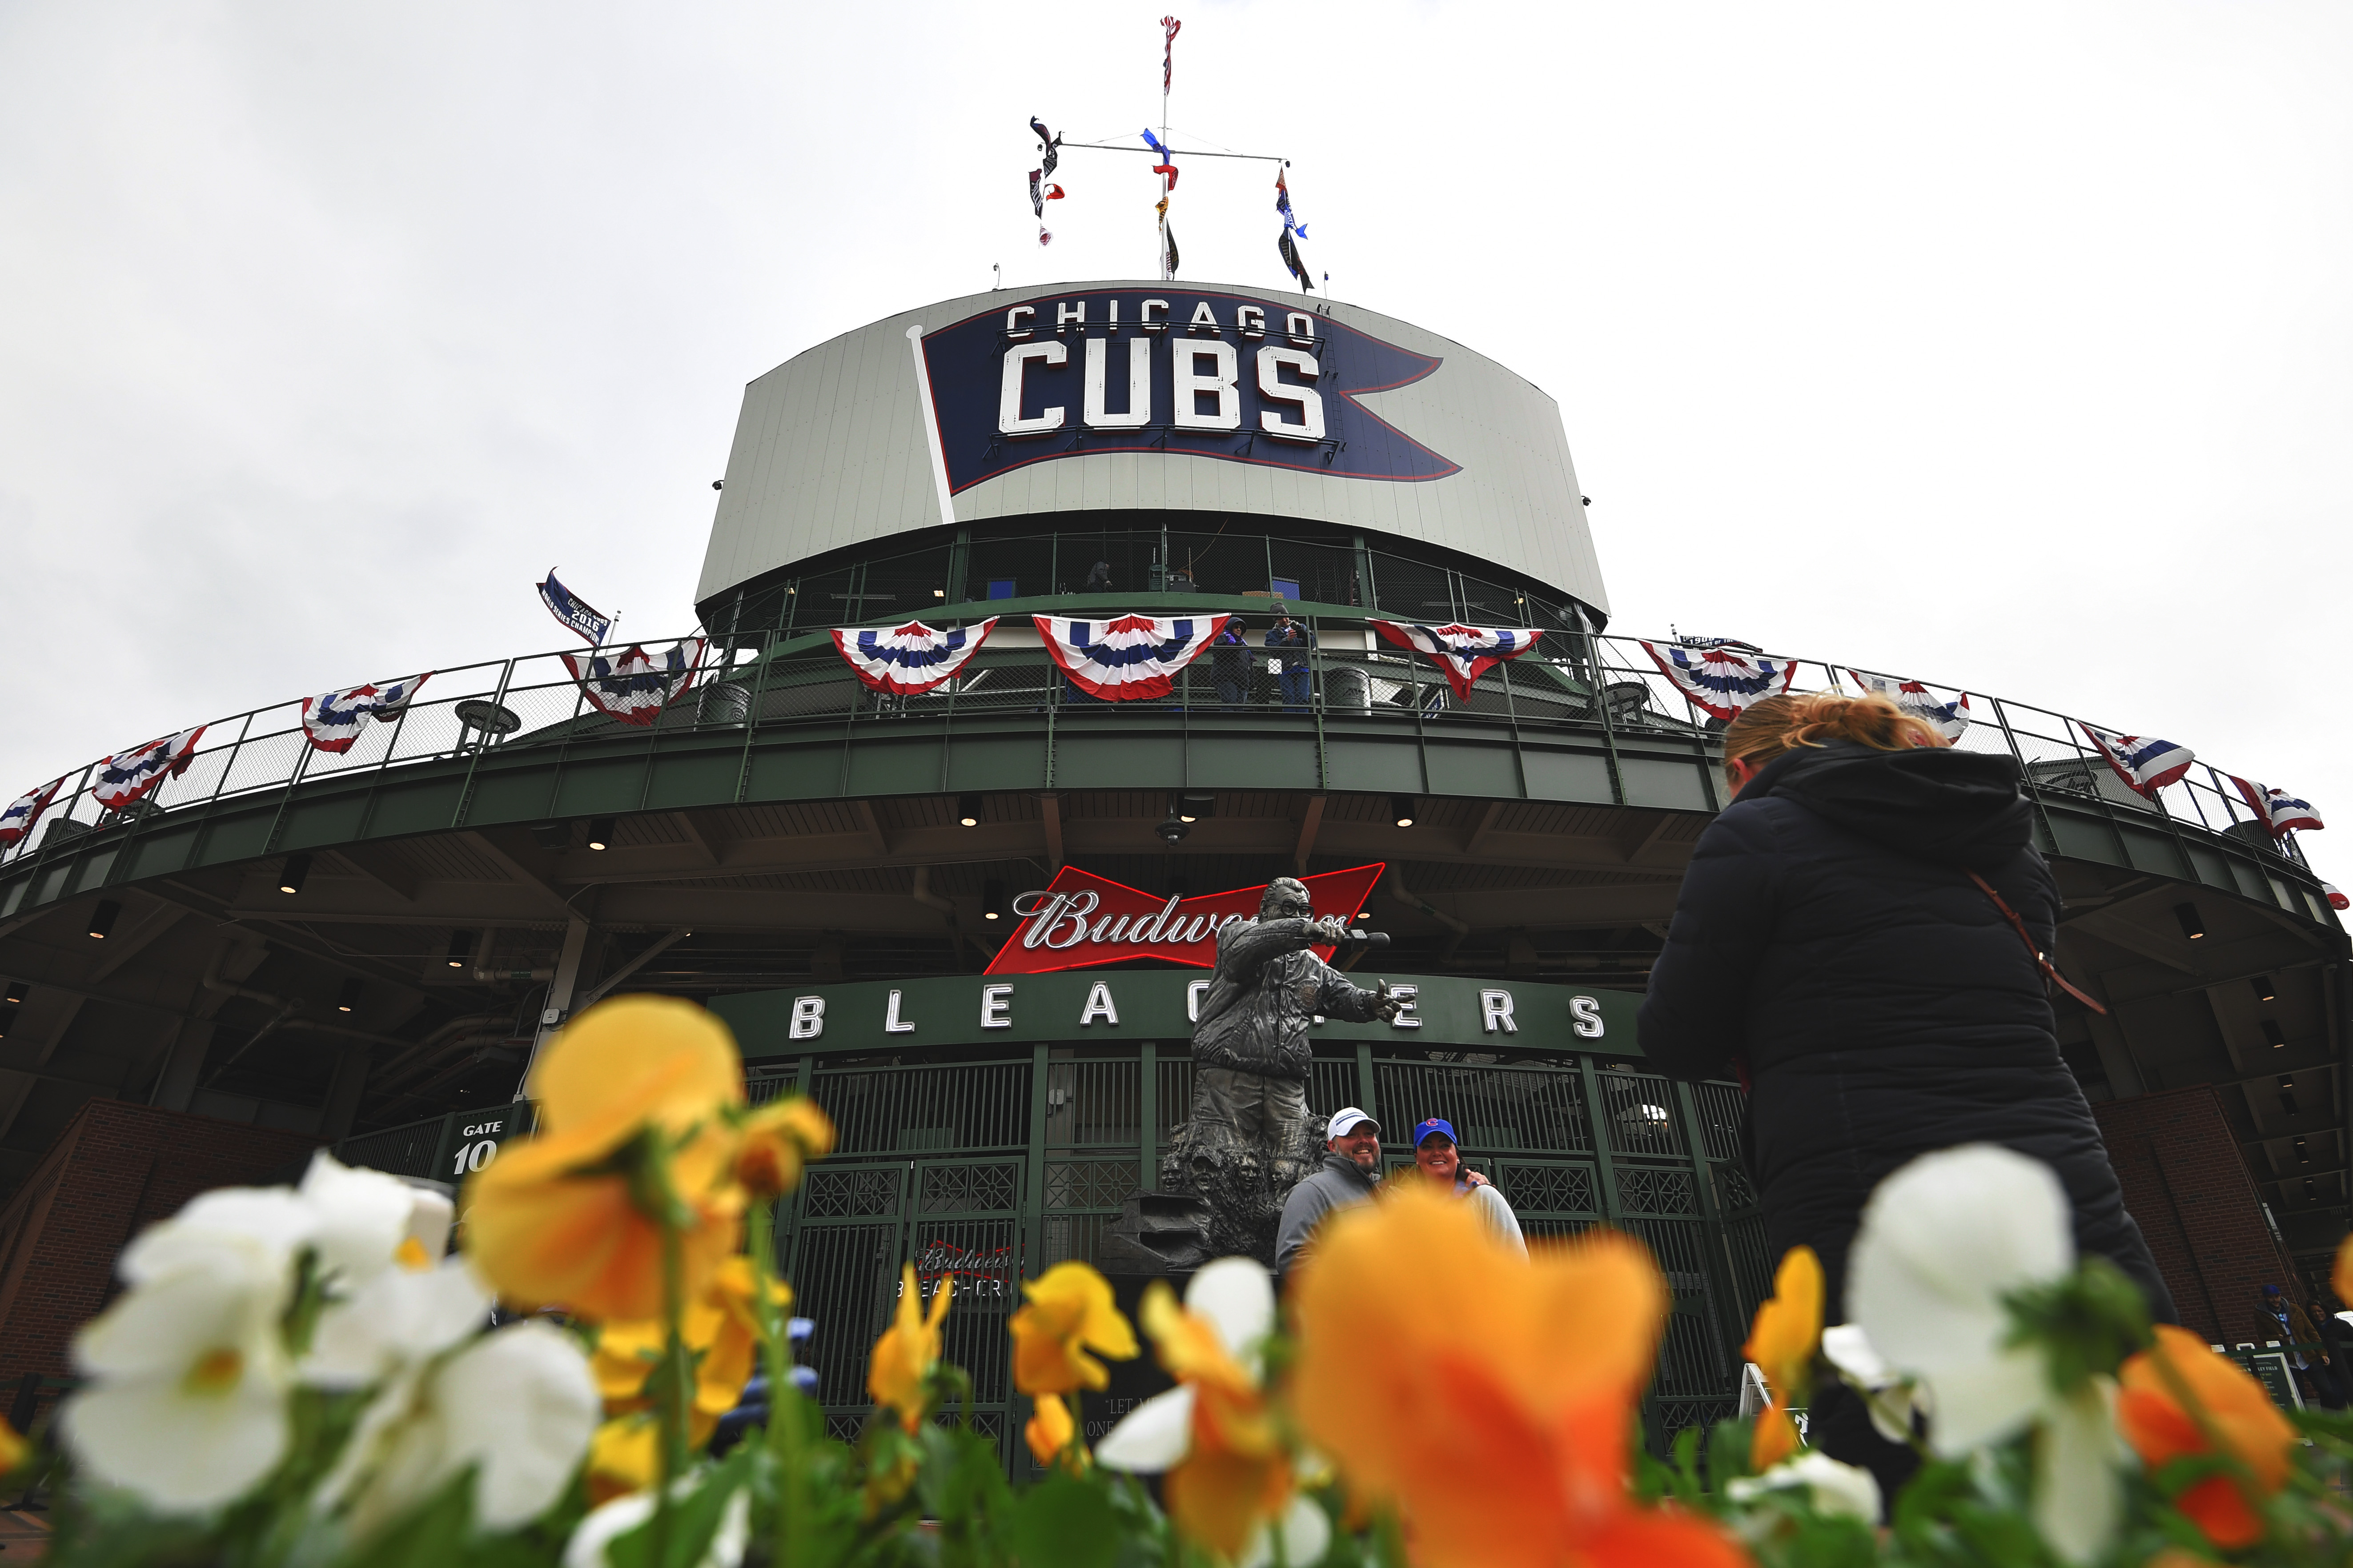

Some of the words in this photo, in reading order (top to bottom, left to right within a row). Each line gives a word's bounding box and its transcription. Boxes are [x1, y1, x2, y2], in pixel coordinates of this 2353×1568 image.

[1006, 299, 1316, 349] CHICAGO
[999, 337, 1327, 444] CUBS
[542, 588, 554, 609] WORLD
[553, 605, 570, 624] SERIES
[571, 610, 599, 632] 2016
[789, 978, 1604, 1039] BLEACERS
[463, 1121, 503, 1136] GATE
[1426, 1118, 1438, 1127] C
[454, 1140, 497, 1175] 10
[1087, 1421, 1114, 1436] ONE
